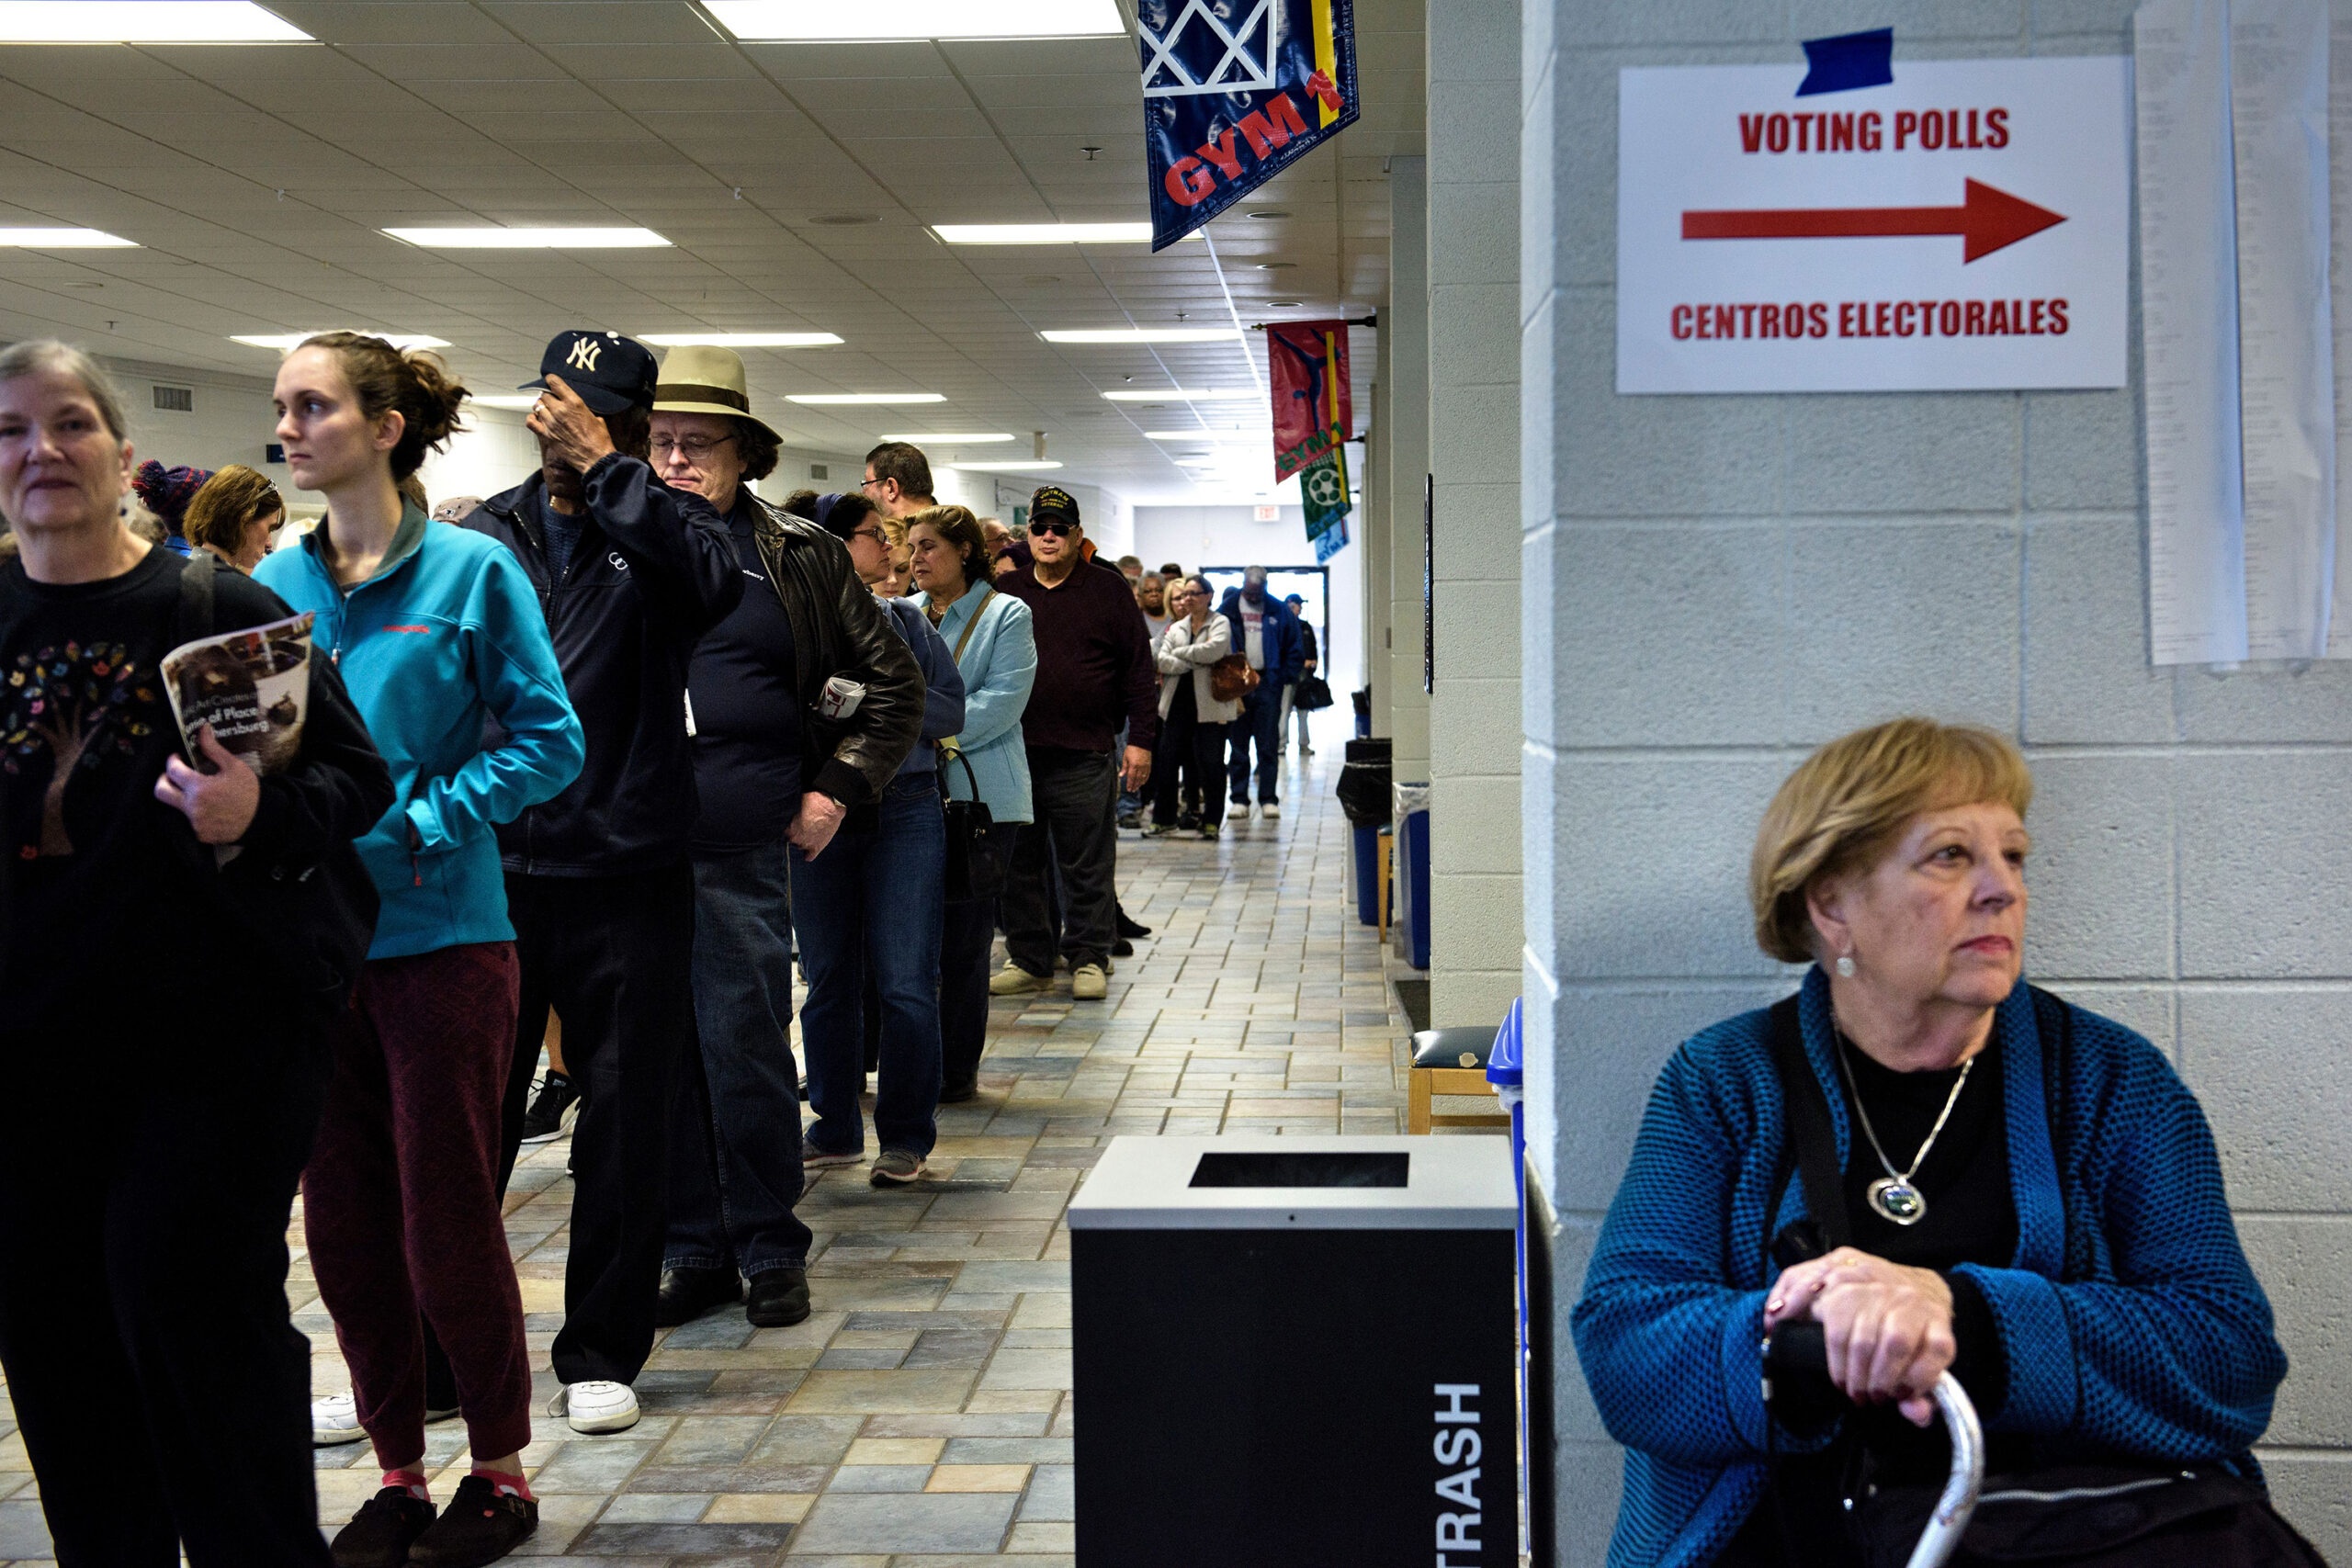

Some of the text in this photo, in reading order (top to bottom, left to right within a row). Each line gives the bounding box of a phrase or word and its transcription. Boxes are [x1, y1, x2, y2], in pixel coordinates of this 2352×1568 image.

[1165, 68, 1345, 207] GYM 1
[1739, 107, 2010, 152] VOTING POLLS
[1670, 299, 2070, 340] CENTROS ELECTORALES
[566, 336, 602, 372] NY
[1278, 421, 1344, 471] GYM 1
[1040, 490, 1069, 501] VIETNAM
[208, 708, 221, 724] of
[223, 706, 258, 720] Place
